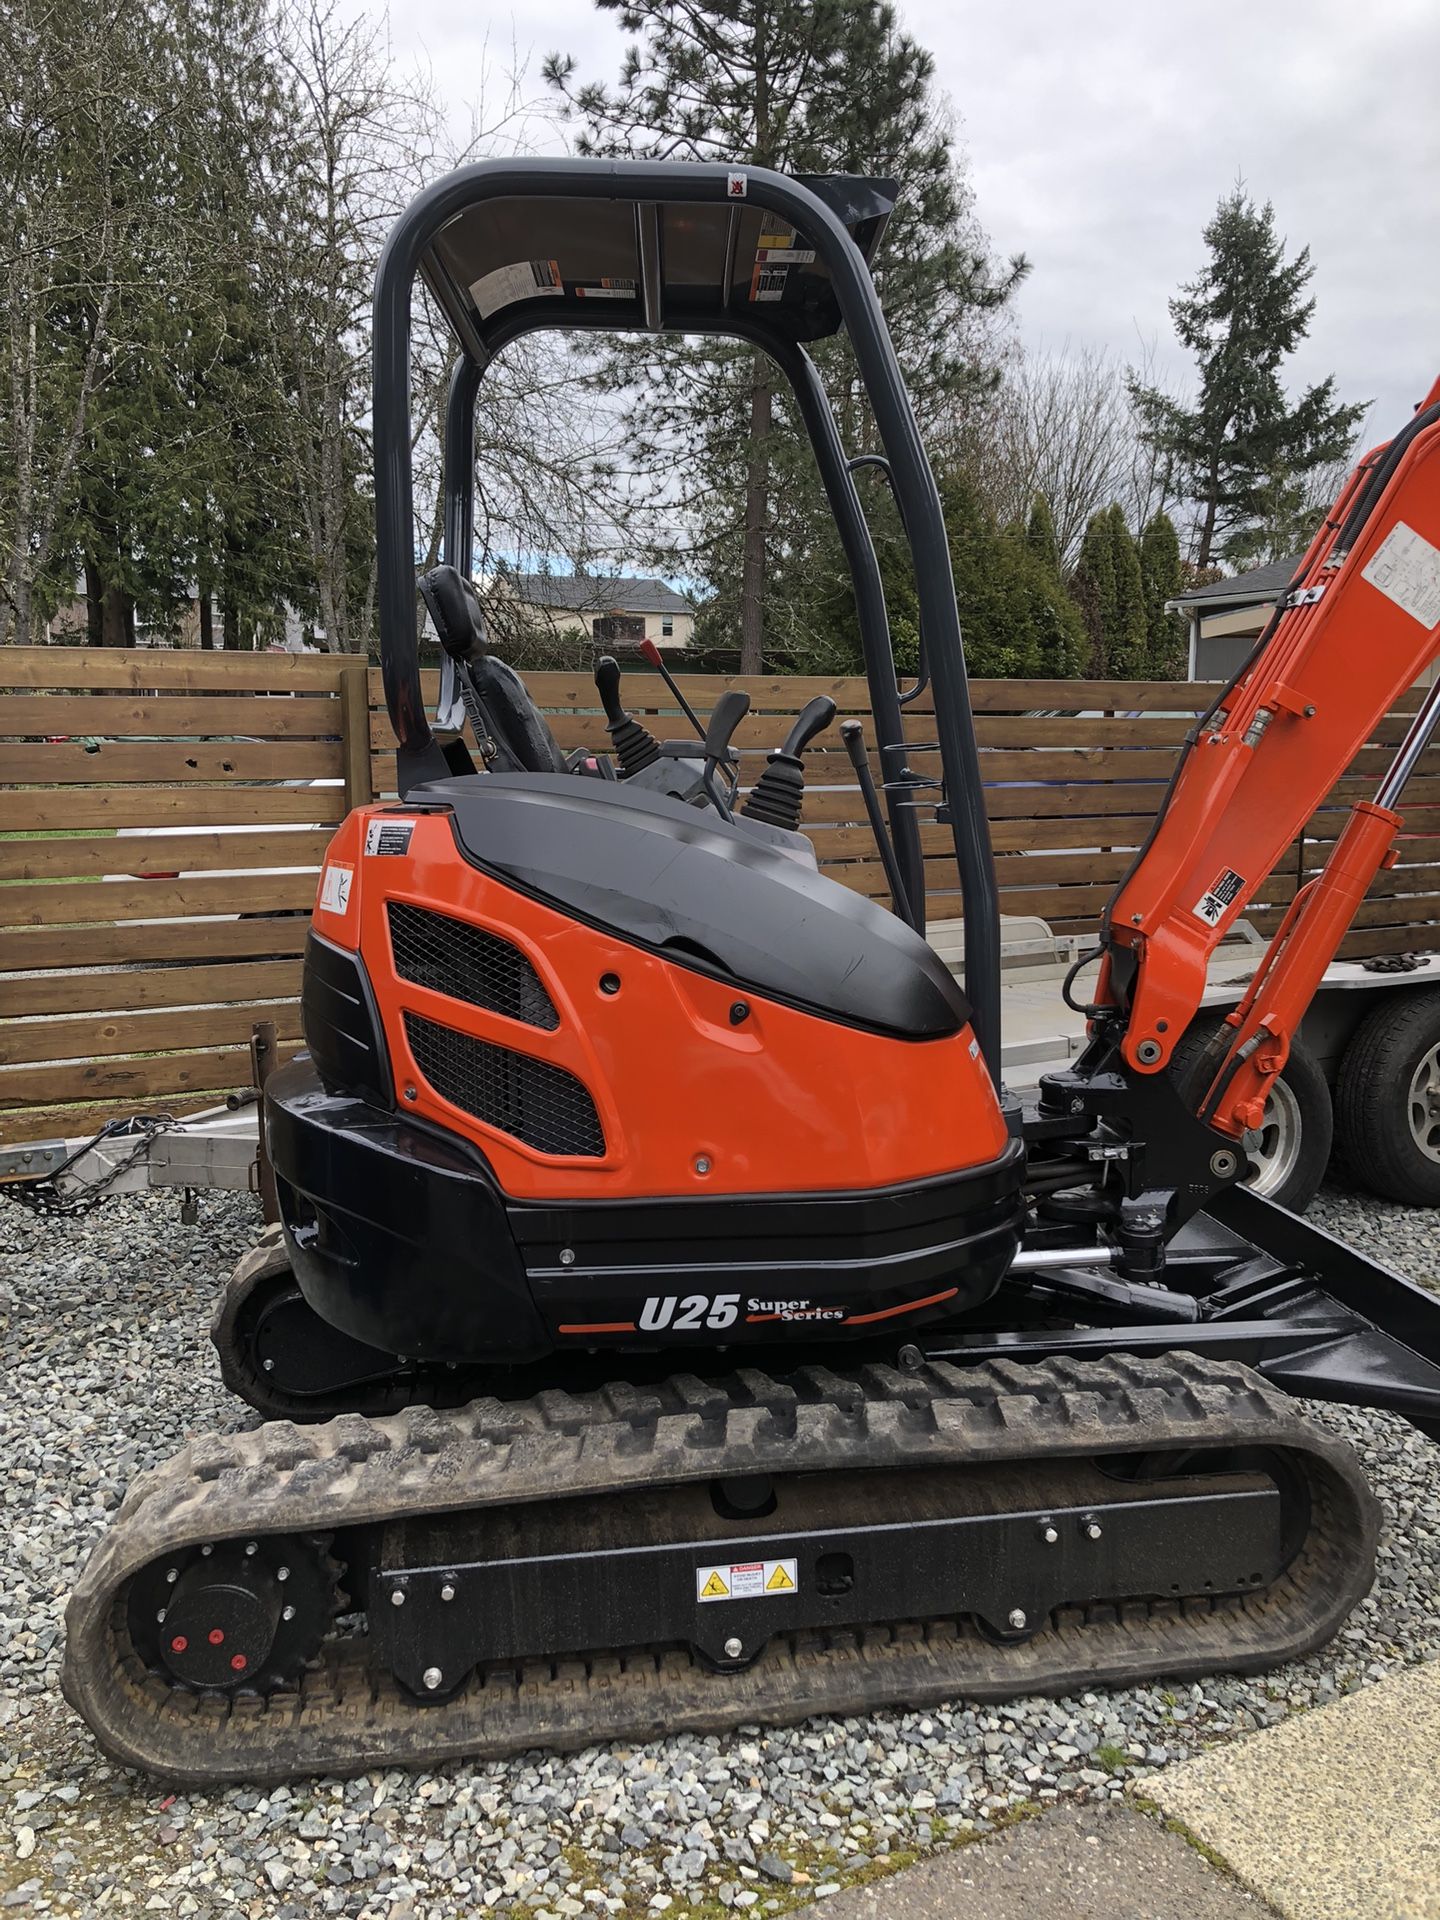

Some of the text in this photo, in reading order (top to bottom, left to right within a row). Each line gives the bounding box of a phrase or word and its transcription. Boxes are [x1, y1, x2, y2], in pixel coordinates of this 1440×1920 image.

[638, 1294, 741, 1331] U25
[747, 1299, 810, 1315] Super
[781, 1308, 844, 1321] Series
